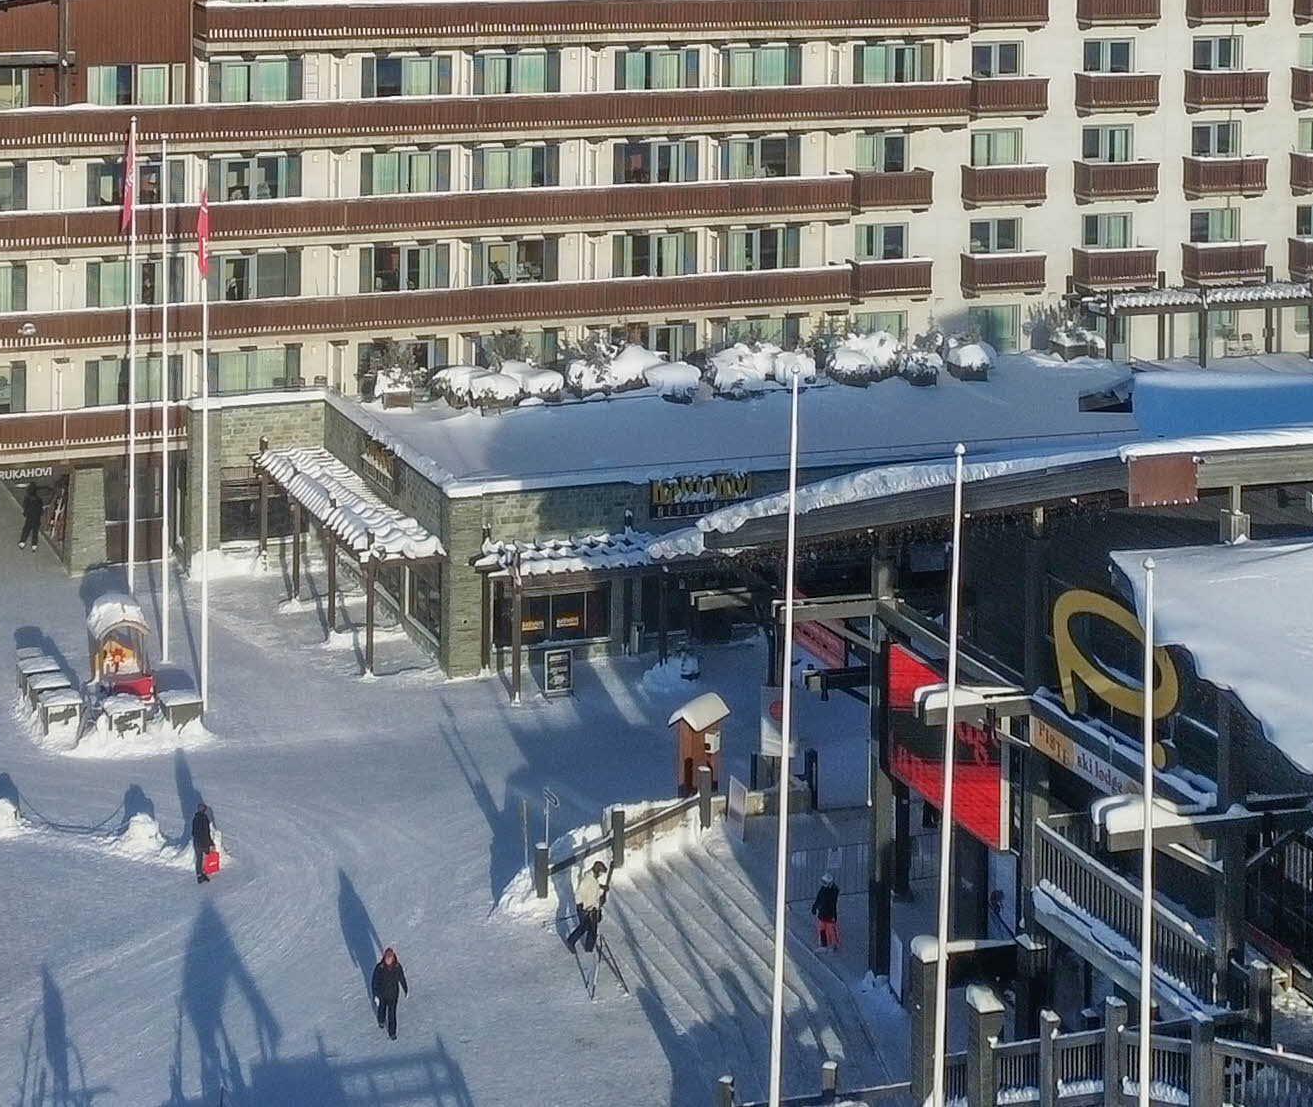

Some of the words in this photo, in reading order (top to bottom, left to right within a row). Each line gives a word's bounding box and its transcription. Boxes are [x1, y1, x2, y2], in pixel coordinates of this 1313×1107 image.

[1039, 721, 1069, 765] PISTE
[1076, 753, 1093, 775] ski
[1095, 761, 1123, 794] lodge
